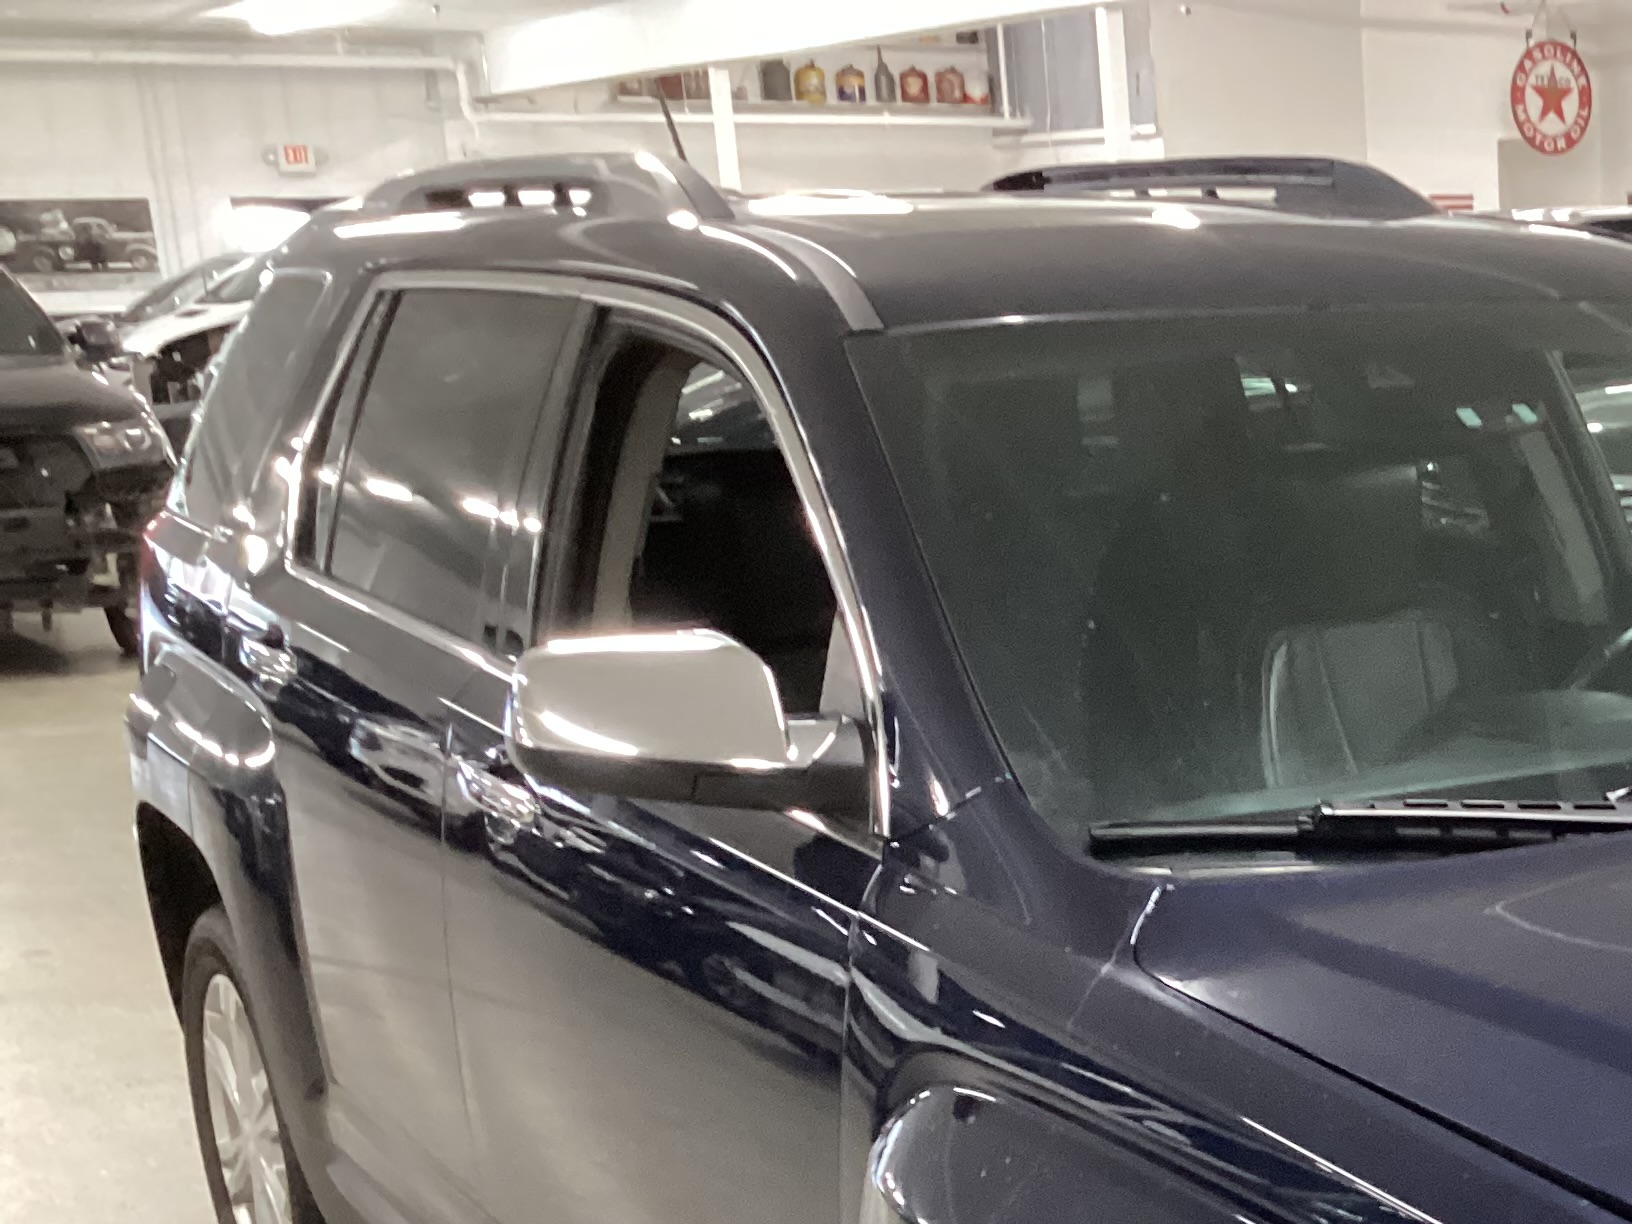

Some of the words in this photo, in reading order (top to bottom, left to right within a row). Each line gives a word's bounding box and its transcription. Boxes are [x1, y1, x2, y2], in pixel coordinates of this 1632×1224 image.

[1516, 43, 1588, 88] GASOLINE
[1534, 74, 1572, 87] TECO
[1514, 103, 1568, 153] MOTOR
[1570, 107, 1589, 140] OIL
